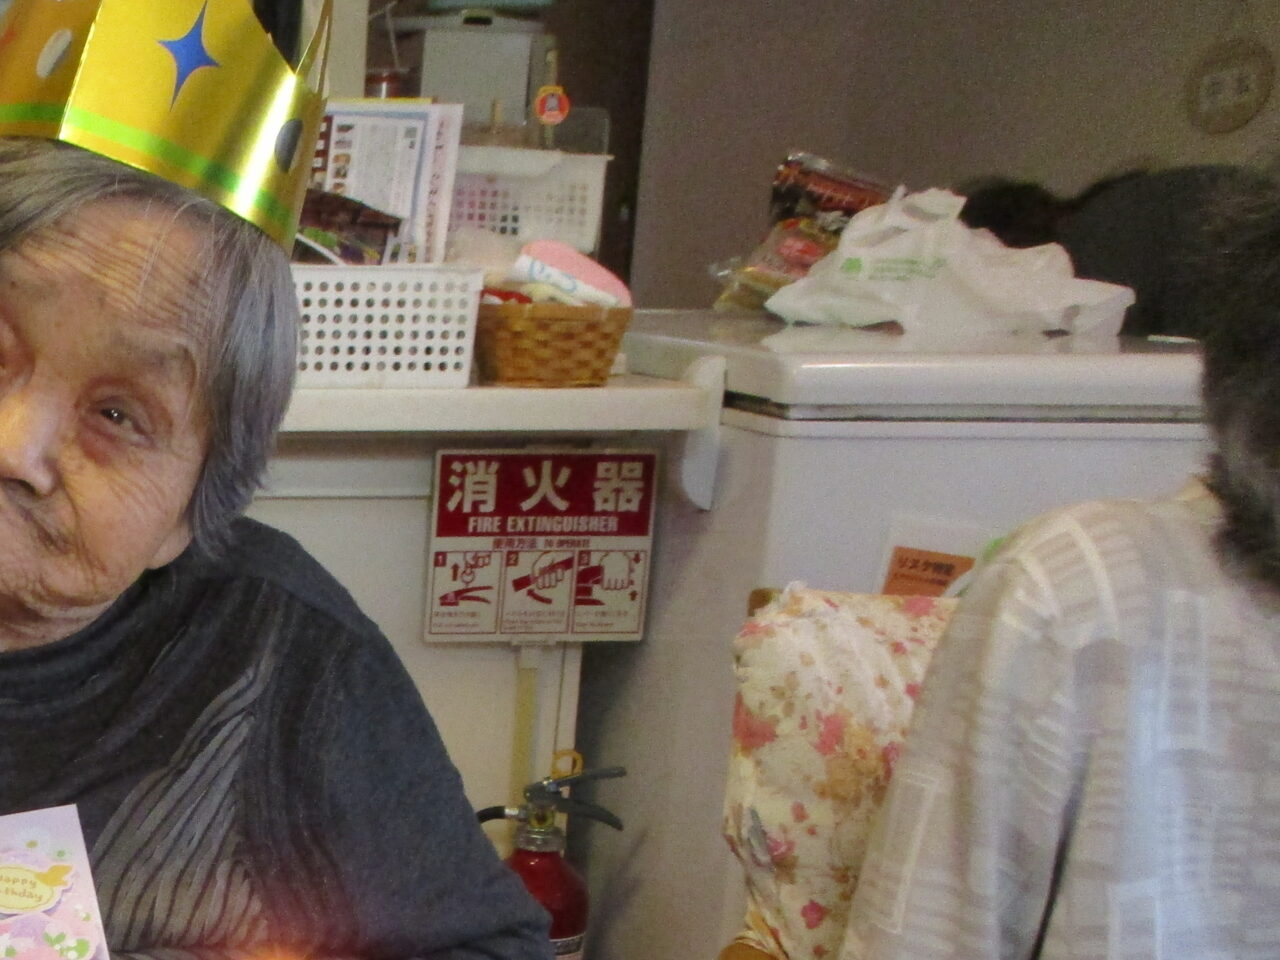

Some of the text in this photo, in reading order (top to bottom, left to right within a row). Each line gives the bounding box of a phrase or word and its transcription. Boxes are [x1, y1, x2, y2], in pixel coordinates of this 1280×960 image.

[446, 460, 644, 514] 消火器
[468, 516, 619, 533] FIRE EXTINGUISHER
